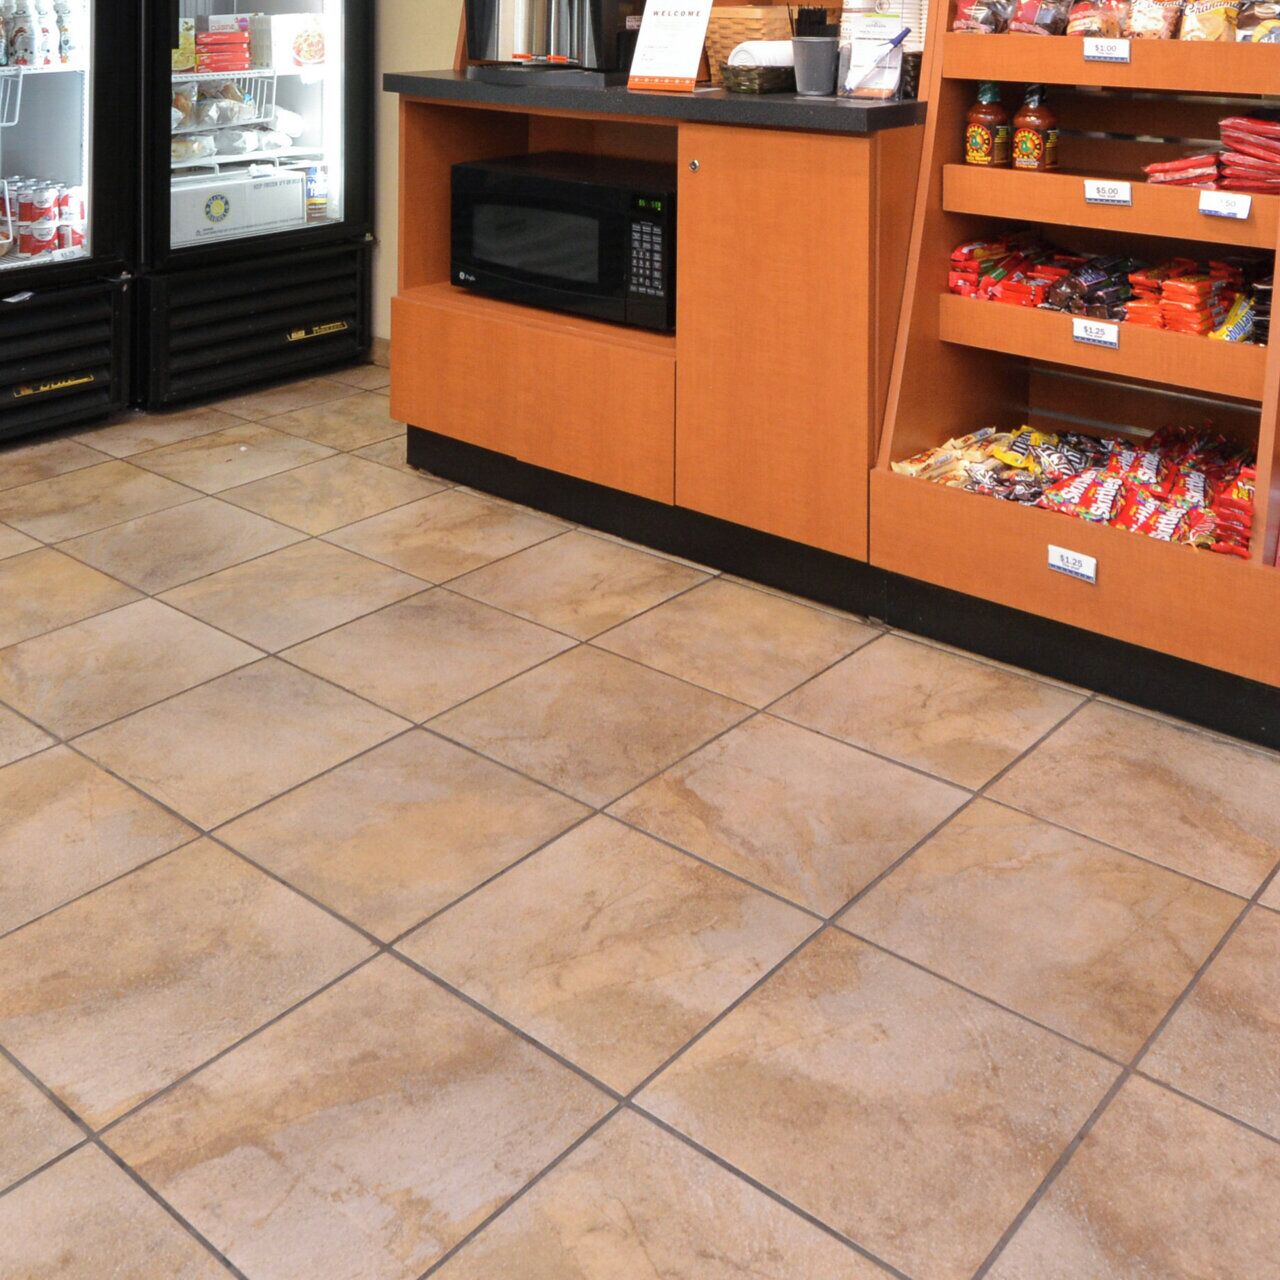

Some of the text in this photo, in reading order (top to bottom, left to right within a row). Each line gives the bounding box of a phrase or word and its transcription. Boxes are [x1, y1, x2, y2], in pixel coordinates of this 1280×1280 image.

[1094, 44, 1117, 52] $1.00
[1096, 186, 1119, 196] $5.00
[1083, 324, 1106, 336] $1.25
[1061, 470, 1097, 505] Skittles
[1090, 477, 1123, 521] Skittles
[1059, 553, 1084, 568] $1.25
